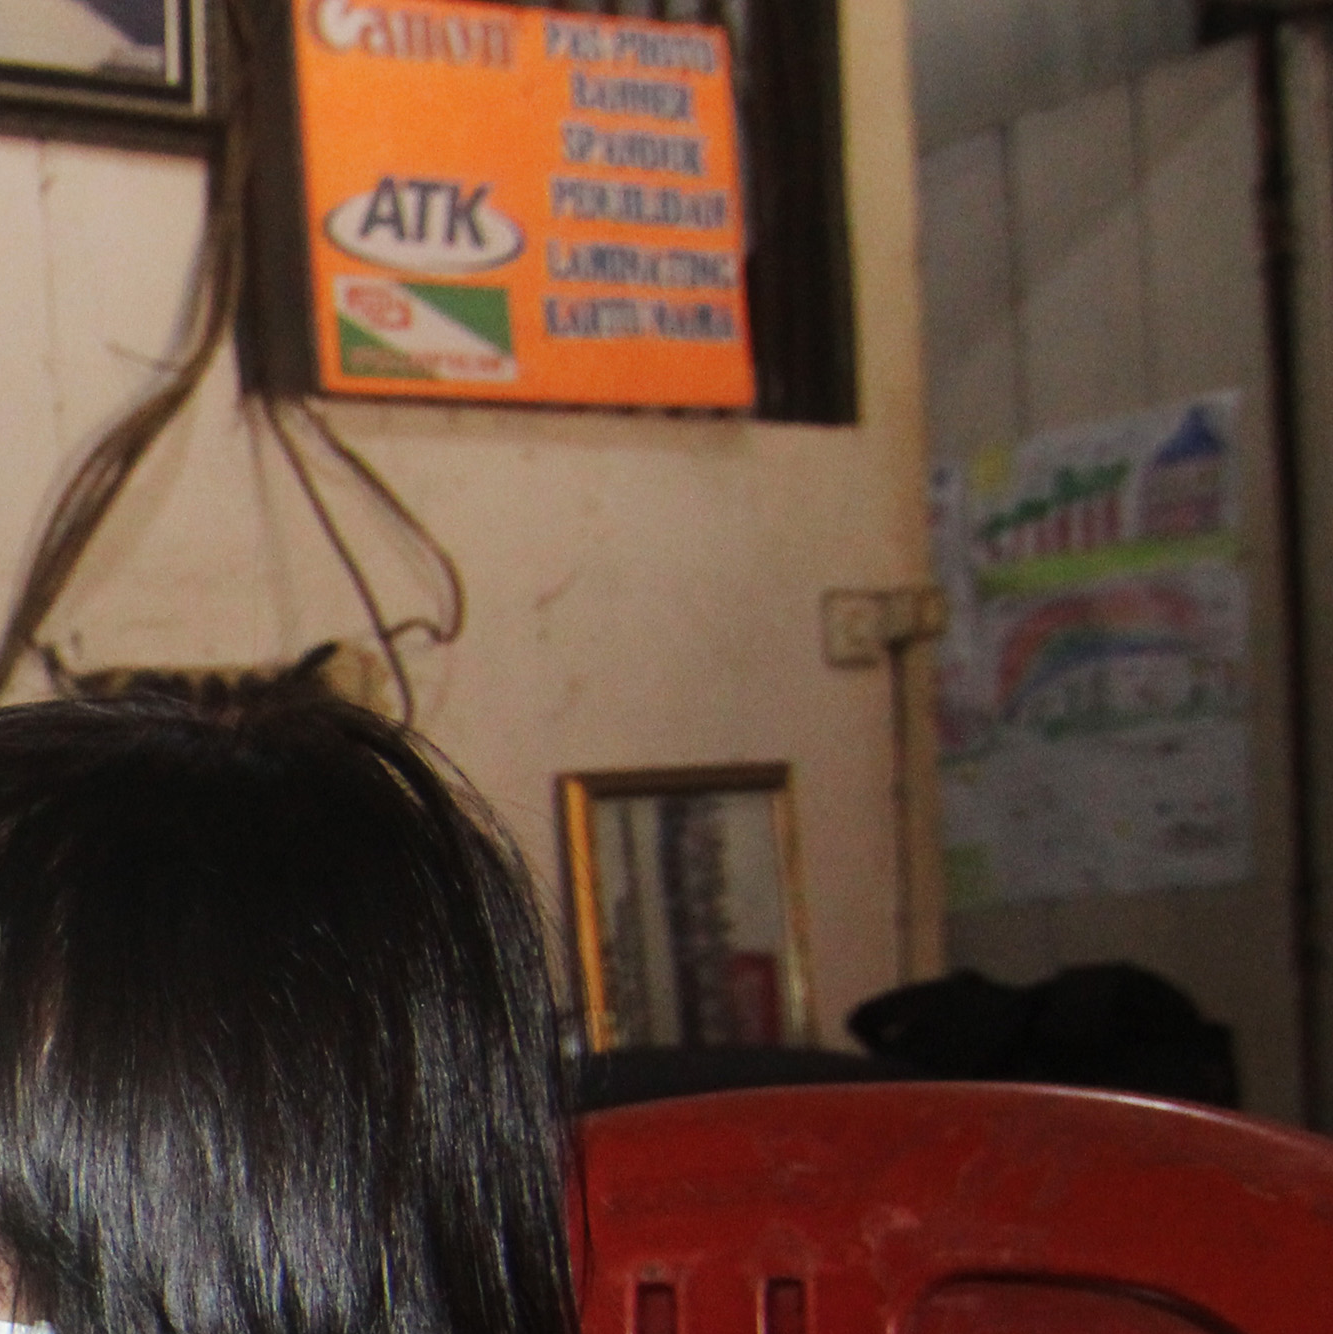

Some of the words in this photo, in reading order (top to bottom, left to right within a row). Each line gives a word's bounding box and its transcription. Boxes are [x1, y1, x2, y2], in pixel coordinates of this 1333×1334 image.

[310, 0, 514, 68] Canon
[563, 122, 703, 176] SPANDUK
[359, 176, 491, 249] ATK
